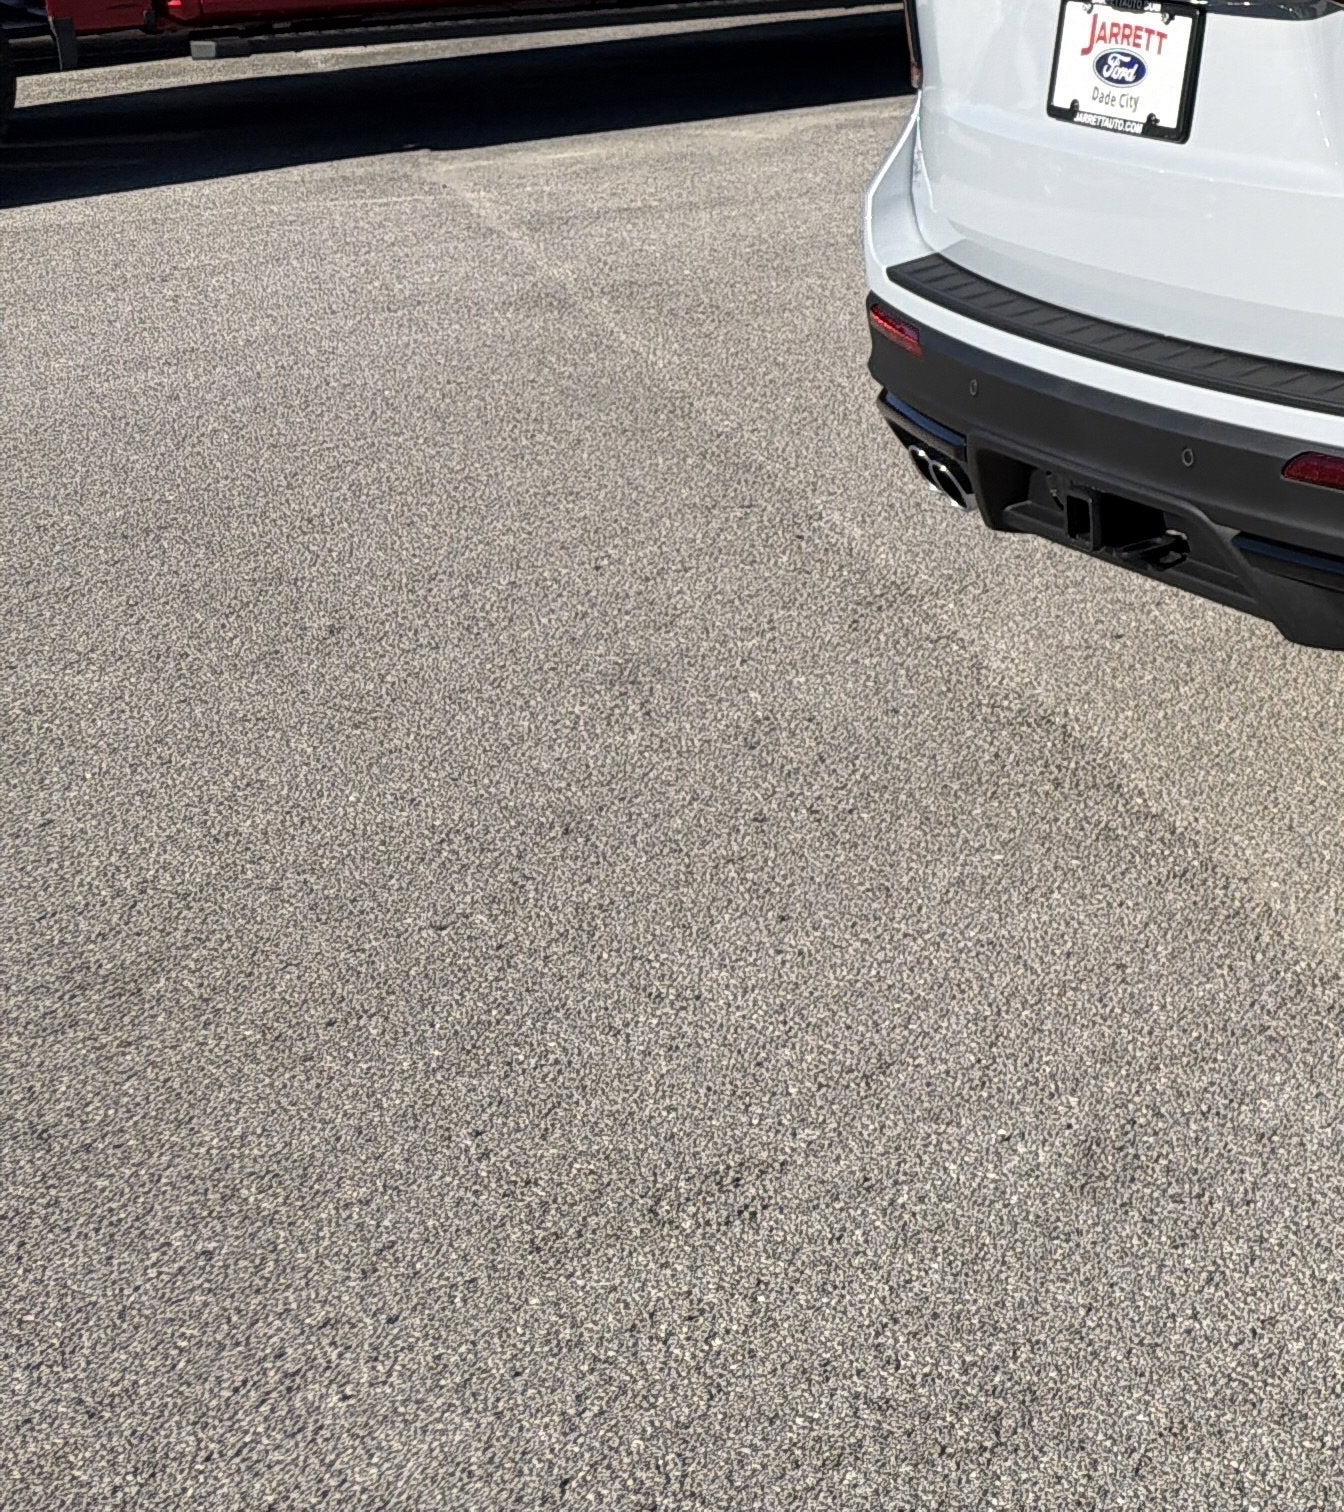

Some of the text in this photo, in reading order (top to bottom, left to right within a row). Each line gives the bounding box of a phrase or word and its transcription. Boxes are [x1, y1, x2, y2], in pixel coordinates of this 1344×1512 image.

[1081, 13, 1167, 56] JARRETT
[1102, 53, 1139, 82] Ford
[1092, 86, 1140, 112] Dade City
[1074, 112, 1144, 134] JARRETTAUTO.COM
